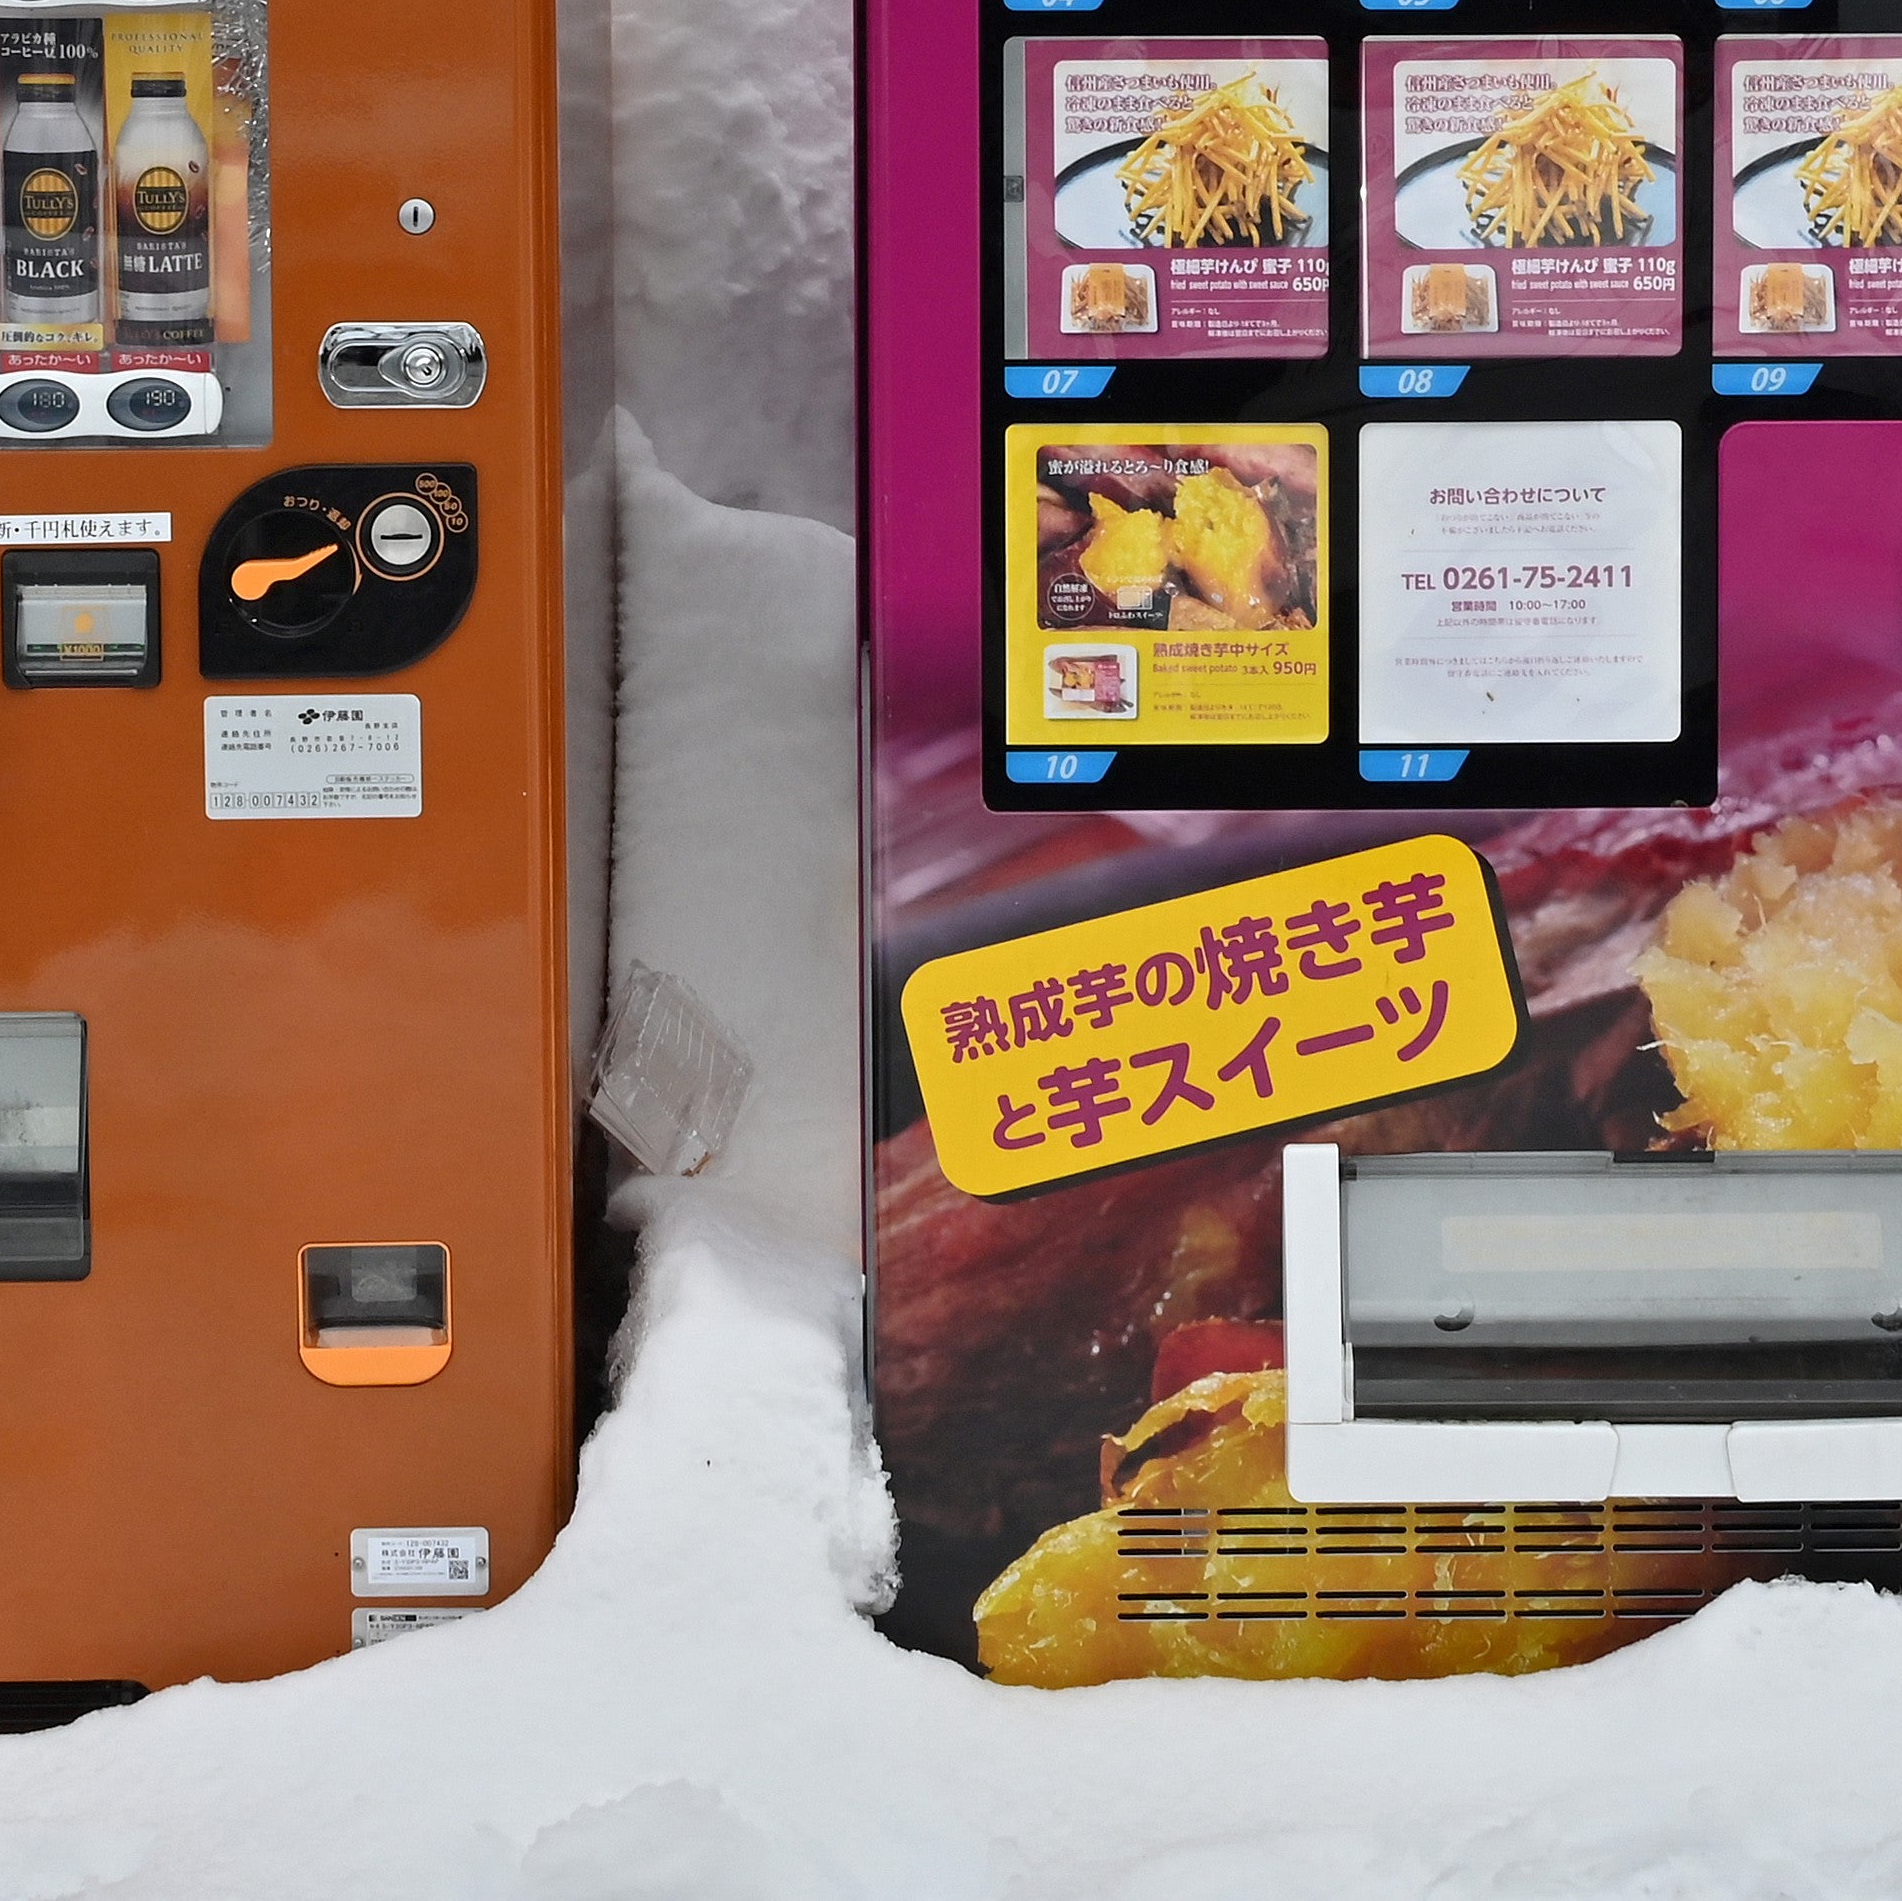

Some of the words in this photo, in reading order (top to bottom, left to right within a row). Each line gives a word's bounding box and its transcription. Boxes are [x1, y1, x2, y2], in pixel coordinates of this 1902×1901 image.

[1, 47, 56, 59] コーヒー豆
[60, 43, 99, 59] 100%
[129, 44, 184, 55] QUALITY
[1065, 96, 1194, 114] 冷凍のまま食べると
[148, 253, 203, 273] LATTE
[1638, 258, 1676, 275] 110g
[1633, 277, 1675, 291] 650円
[1043, 369, 1078, 394] 07
[1399, 369, 1433, 393] 08
[1751, 367, 1786, 392] 09
[1430, 487, 1606, 505] お問い合わせについて
[1402, 574, 1436, 590] TEL
[1443, 565, 1632, 589] 0261-75-2411
[1451, 601, 1497, 612] 営業時間
[290, 742, 399, 753] (026)267-7006
[1047, 756, 1078, 779] 10
[1400, 754, 1431, 778] 11
[940, 873, 1455, 1063] 熟成芋の焼き芋
[991, 979, 1450, 1151] と芋スイーツ
